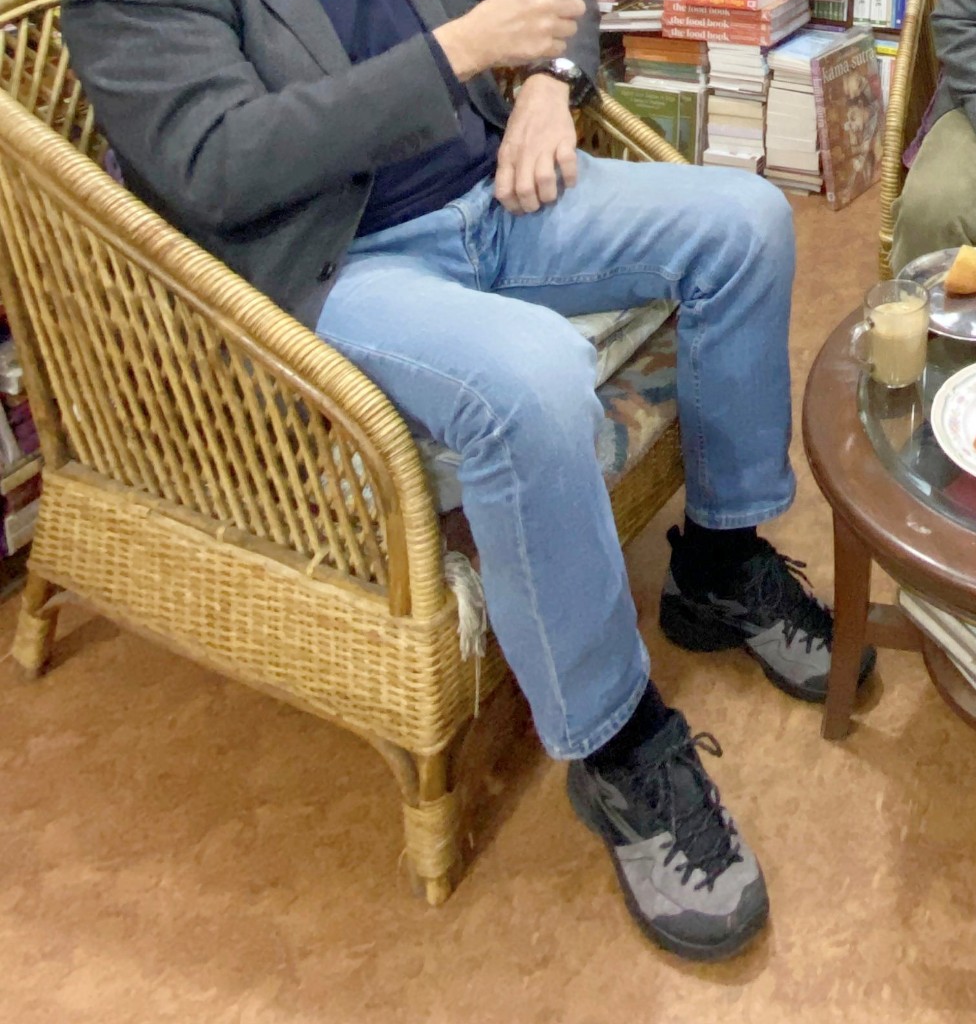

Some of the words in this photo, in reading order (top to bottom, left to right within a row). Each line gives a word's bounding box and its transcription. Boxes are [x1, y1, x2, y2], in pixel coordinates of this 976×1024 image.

[672, 2, 686, 12] the
[670, 16, 685, 25] the
[686, 17, 706, 26] food
[707, 18, 730, 28] book
[671, 28, 685, 37] the
[686, 29, 706, 39] food
[707, 31, 730, 41] book
[821, 62, 850, 84] kama
[851, 48, 875, 68] sutra
